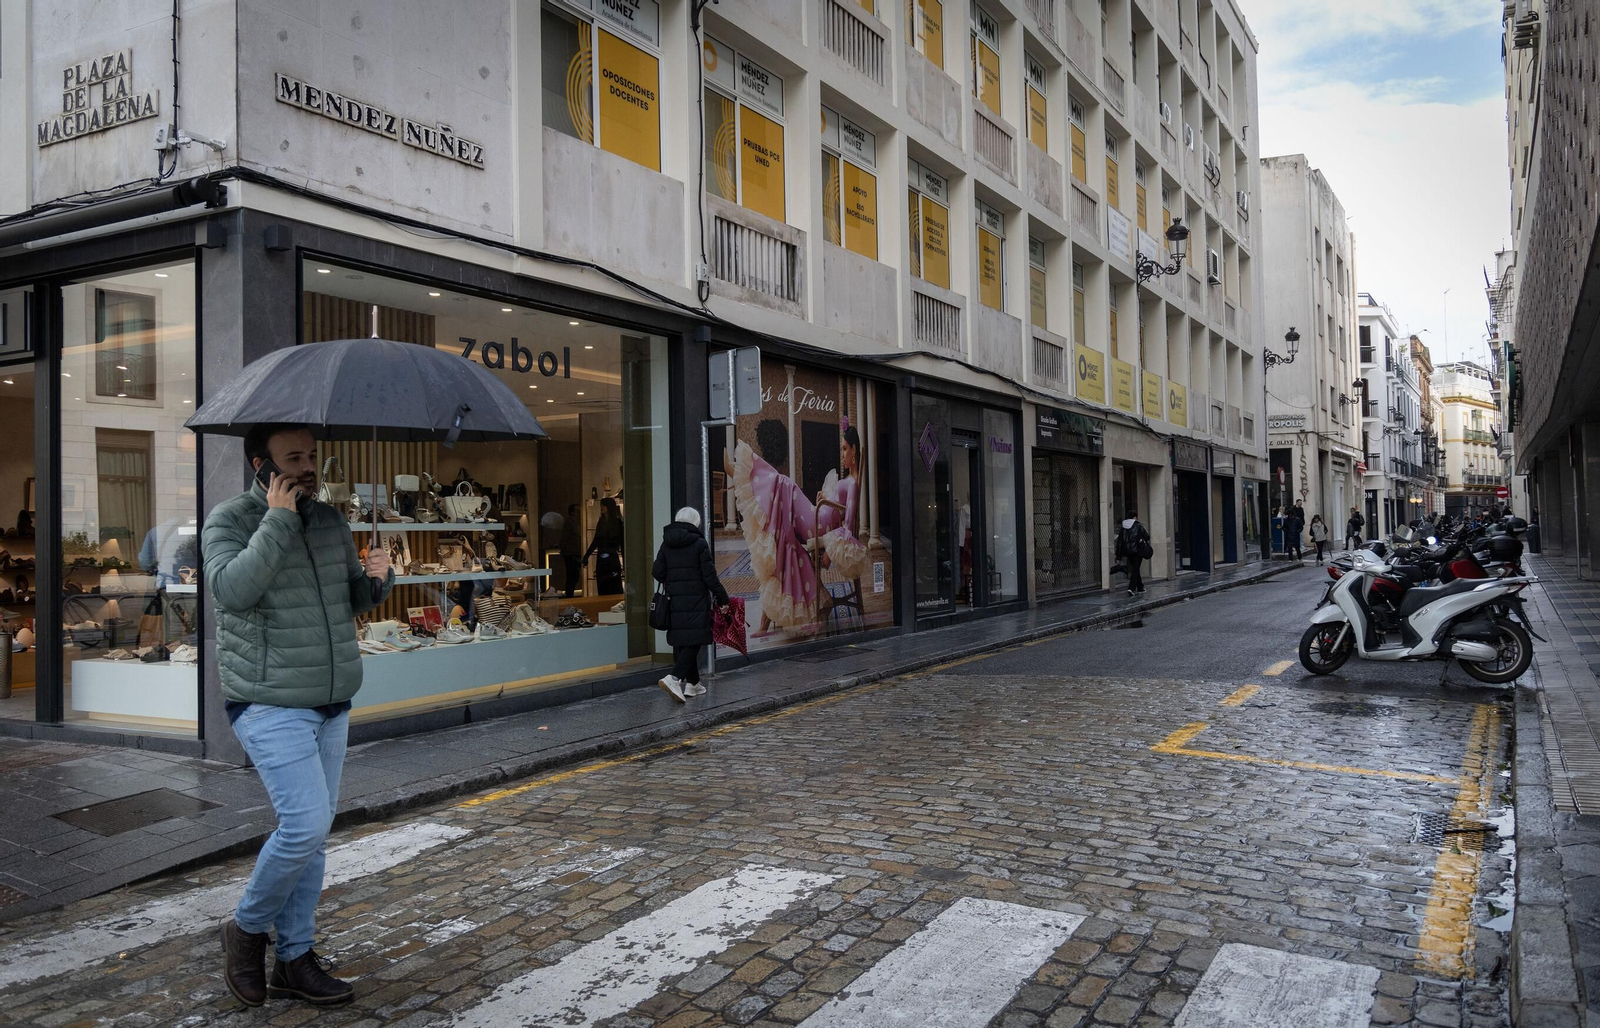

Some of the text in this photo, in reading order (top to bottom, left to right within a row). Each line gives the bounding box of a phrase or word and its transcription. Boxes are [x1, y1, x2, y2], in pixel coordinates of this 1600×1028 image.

[980, 11, 995, 42] MN
[63, 52, 128, 89] PLAZA
[741, 61, 769, 86] MÉNDEZ
[1029, 61, 1042, 87] MN
[62, 77, 128, 113] DE LA
[602, 68, 655, 101] OPOSICIONES
[741, 75, 765, 96] NÚÑEZ
[610, 85, 649, 111] DOCENTES
[37, 93, 155, 146] MAGDALENA
[280, 76, 484, 164] MENDEZ NUÑEZ
[1070, 101, 1082, 123] MN
[844, 122, 865, 142] MÉNDEZ
[743, 138, 780, 162] PRUEBAS PCE
[754, 155, 770, 168] UNED
[852, 186, 867, 198] APOYO
[846, 207, 875, 225] BACHILLERATO
[856, 202, 864, 212] ESO
[459, 337, 571, 379] zabol
[778, 384, 789, 403] de
[788, 386, 835, 415] Feria
[1268, 420, 1304, 429] ROPOLIS
